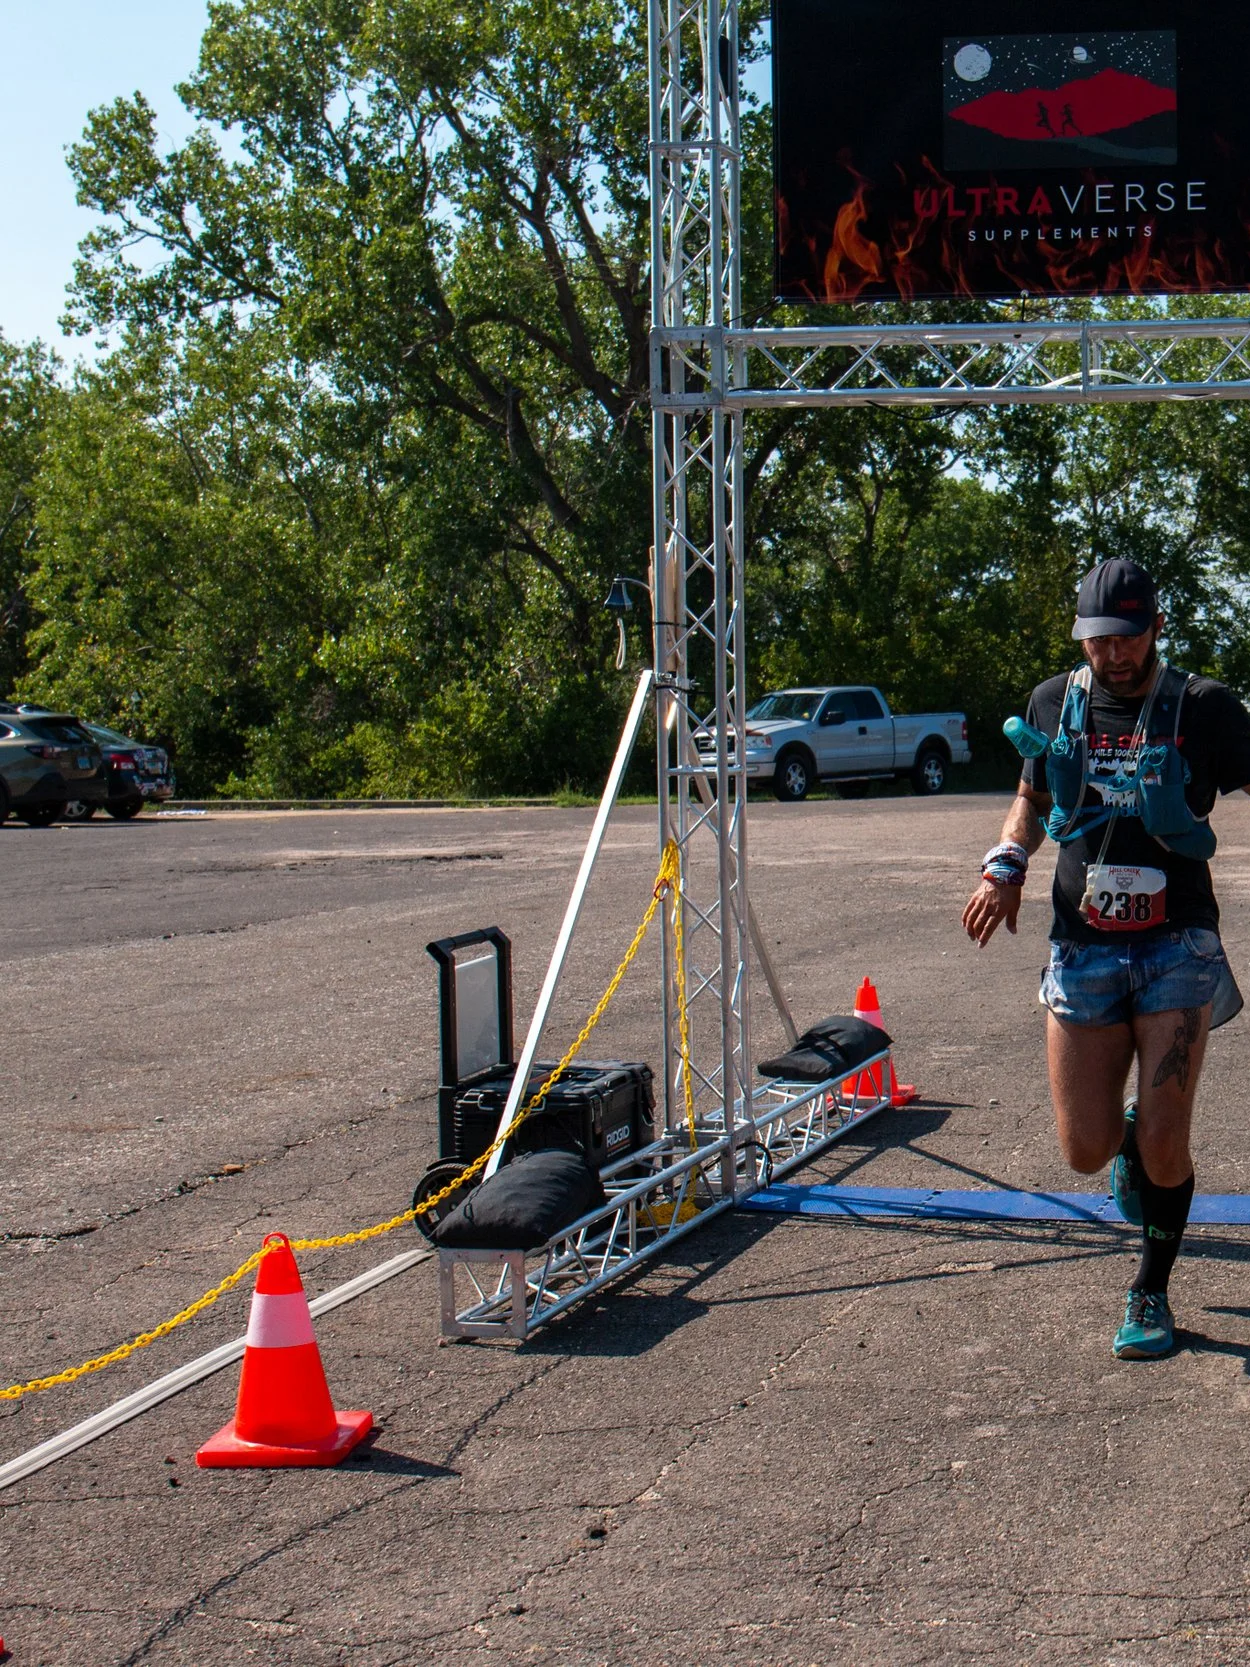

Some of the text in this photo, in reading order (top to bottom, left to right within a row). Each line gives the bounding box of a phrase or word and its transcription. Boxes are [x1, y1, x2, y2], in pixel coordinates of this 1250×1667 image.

[913, 182, 1206, 217] ULTRAVERSE
[968, 225, 1152, 242] SUPPLEMENTS
[1094, 748, 1113, 757] MILE
[1098, 891, 1152, 922] 238
[606, 1125, 630, 1148] RIDGID
